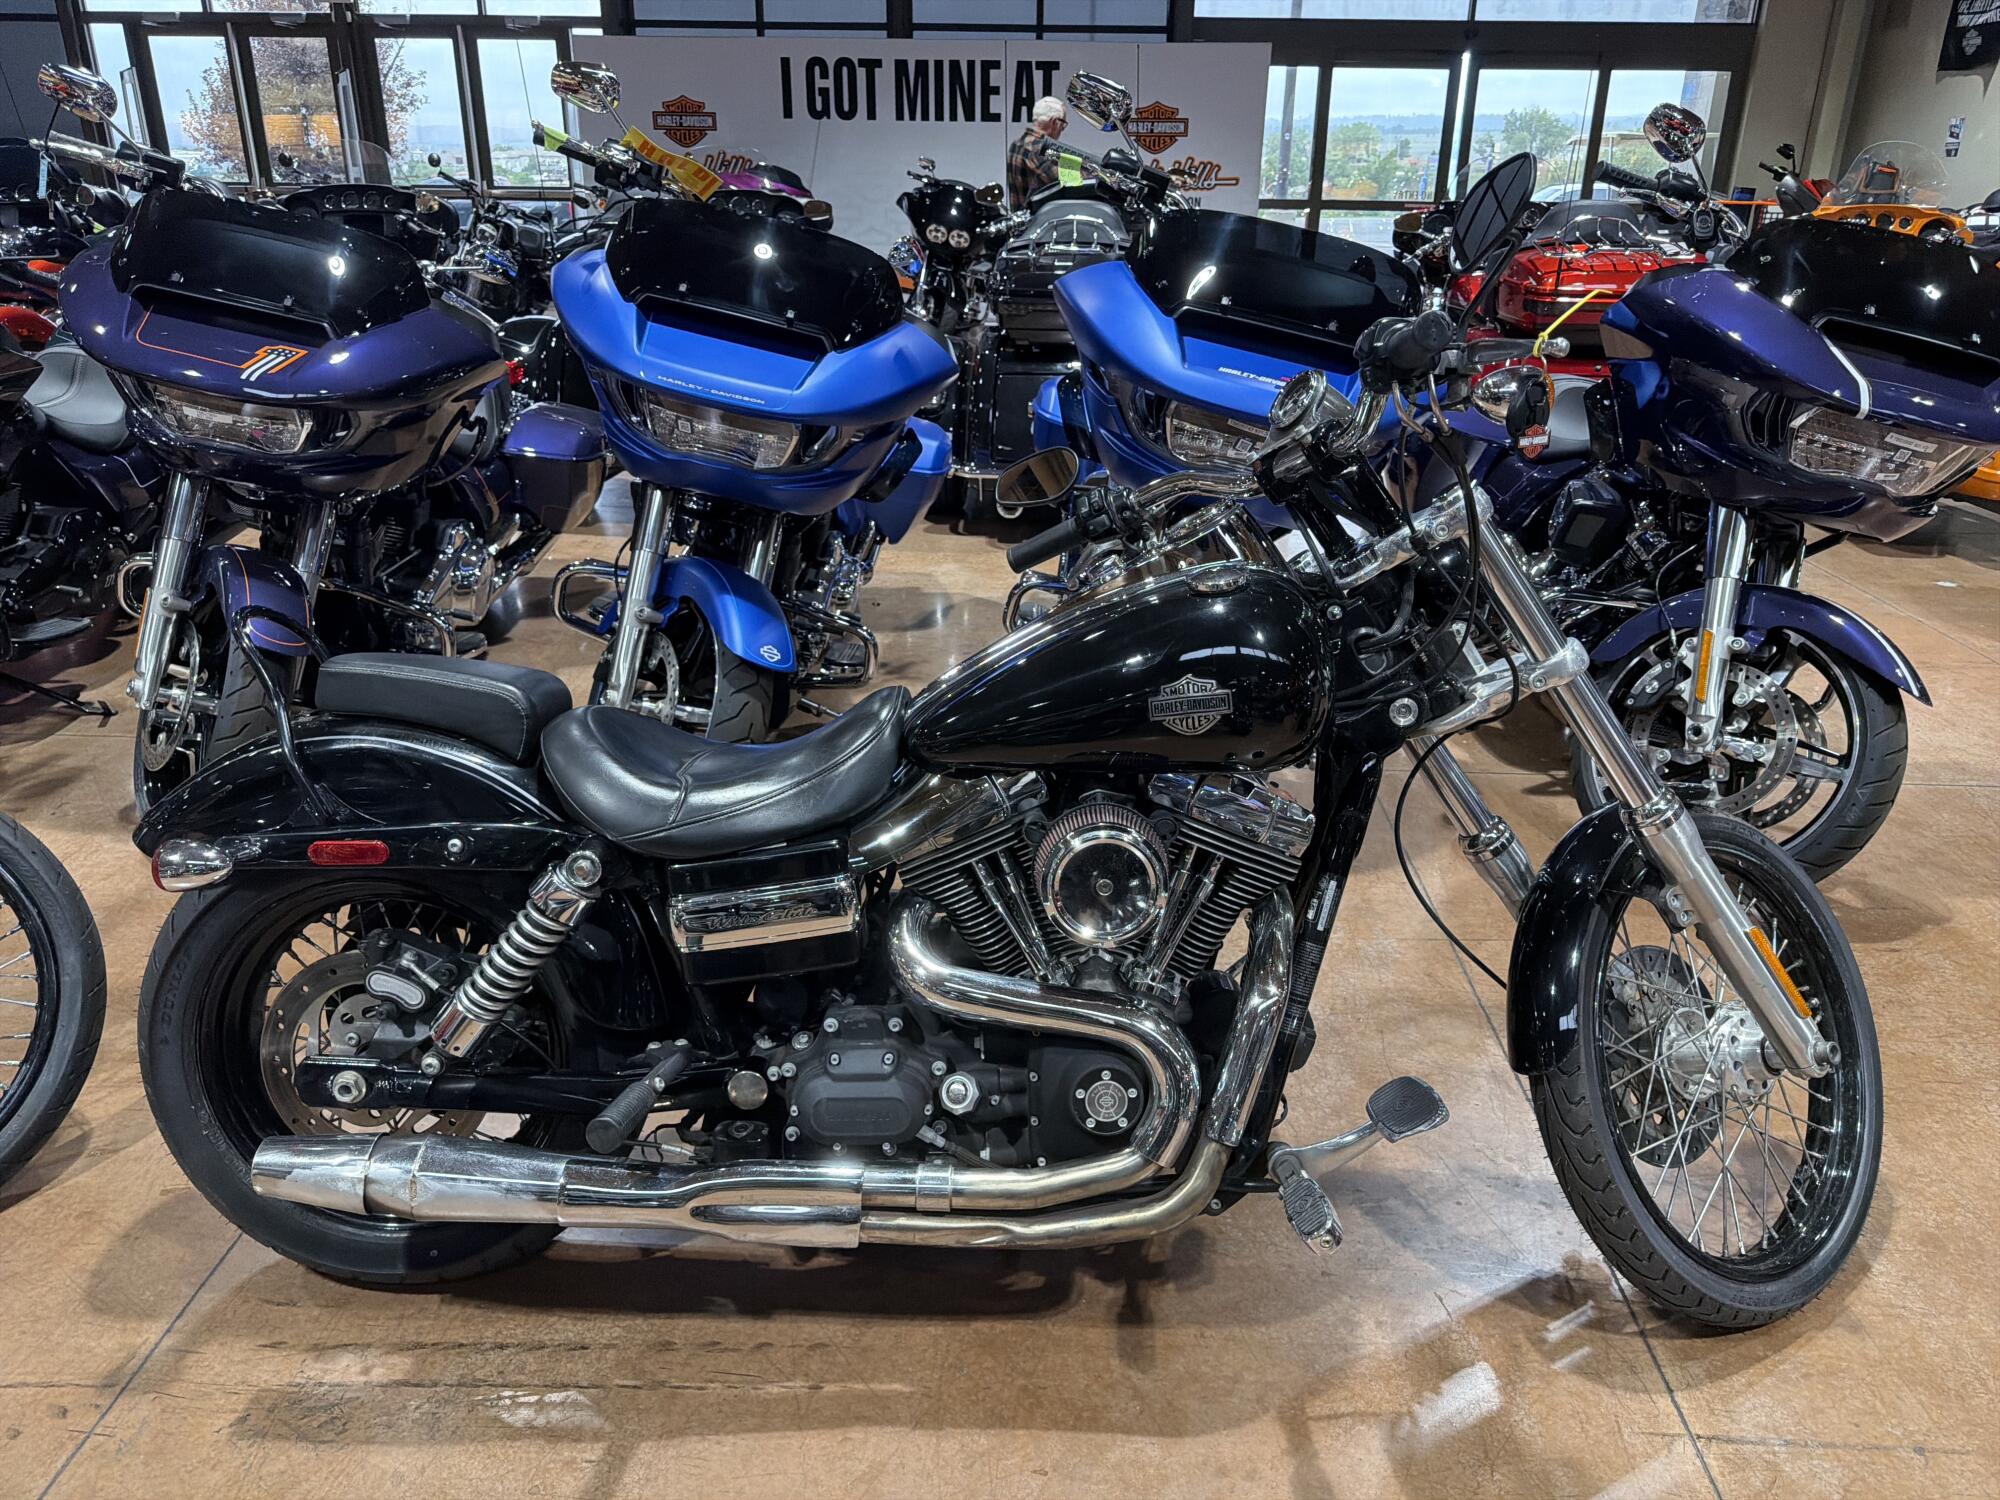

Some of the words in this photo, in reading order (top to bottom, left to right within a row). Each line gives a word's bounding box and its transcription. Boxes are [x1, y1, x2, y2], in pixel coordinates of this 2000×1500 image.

[780, 56, 793, 119] I
[805, 56, 882, 120] GOT
[894, 58, 1002, 122] MINE
[1012, 60, 1060, 122] AT
[668, 102, 699, 112] MOTOR
[1142, 107, 1173, 118] MOTOR
[671, 130, 700, 143] CYCLES
[1141, 136, 1171, 150] CYCLES
[1218, 366, 1287, 387] HARLEY-DAVID
[657, 375, 766, 405] HARLEY-DAVIDSON
[1169, 681, 1208, 697] MOTOR
[1153, 695, 1227, 715] HARLEY-DAVIDSON
[1172, 715, 1211, 731] CYCLES
